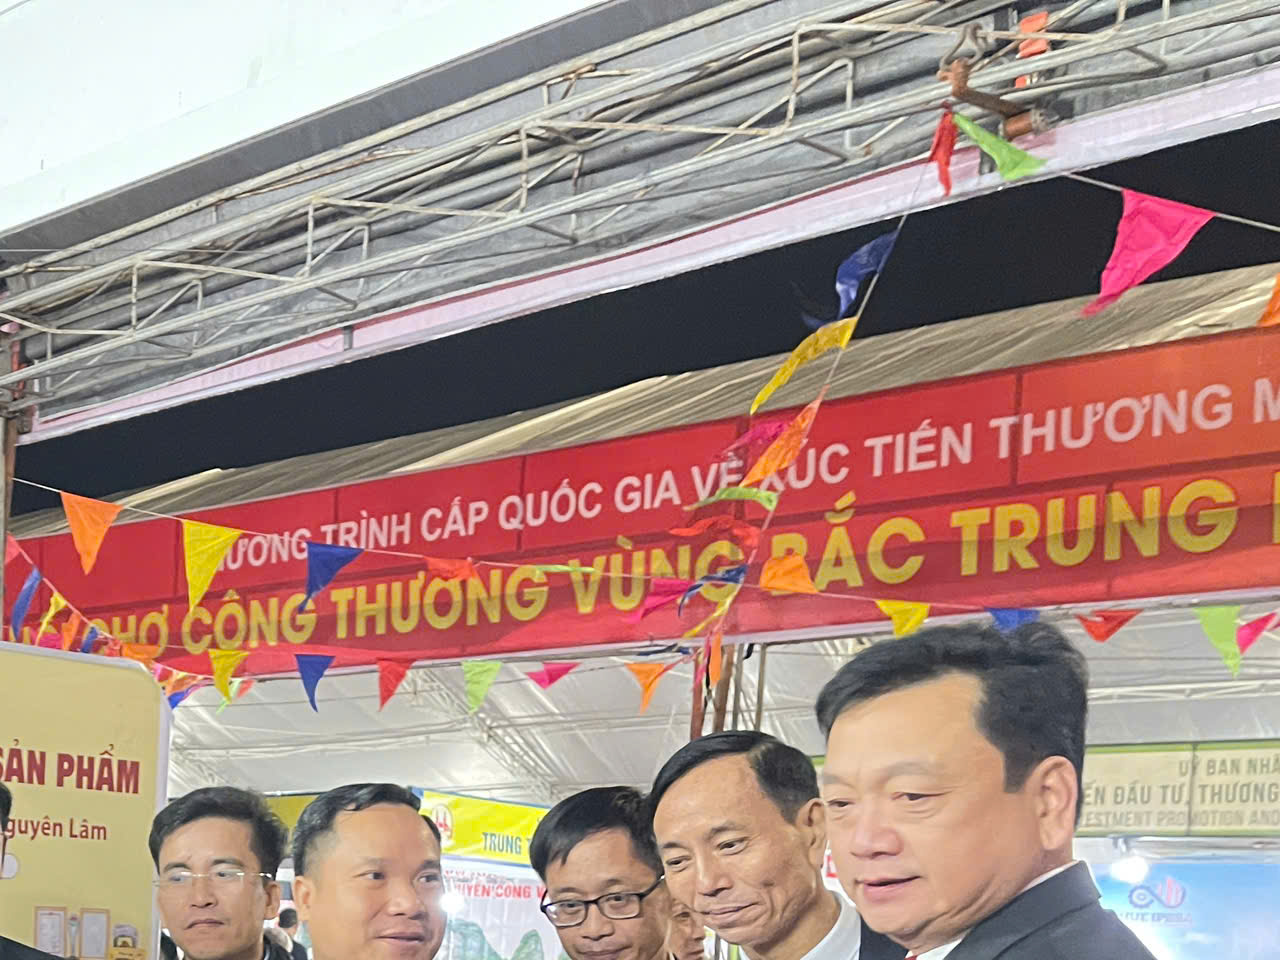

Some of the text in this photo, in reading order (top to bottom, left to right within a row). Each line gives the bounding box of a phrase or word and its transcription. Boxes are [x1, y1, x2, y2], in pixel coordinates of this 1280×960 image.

[420, 496, 489, 543] CẤP
[499, 478, 604, 531] QUỐC
[614, 469, 682, 513] GIA
[864, 418, 973, 479] TIẾN
[990, 383, 1233, 459] THƯƠNG
[182, 588, 318, 656] CÔNG
[330, 564, 550, 640] THƯƠNG
[951, 478, 1240, 577] TRUNG
[56, 743, 140, 794] PHẨM
[5, 815, 63, 841] guyên
[70, 817, 108, 841] Lâm
[482, 831, 522, 855] TRUNG
